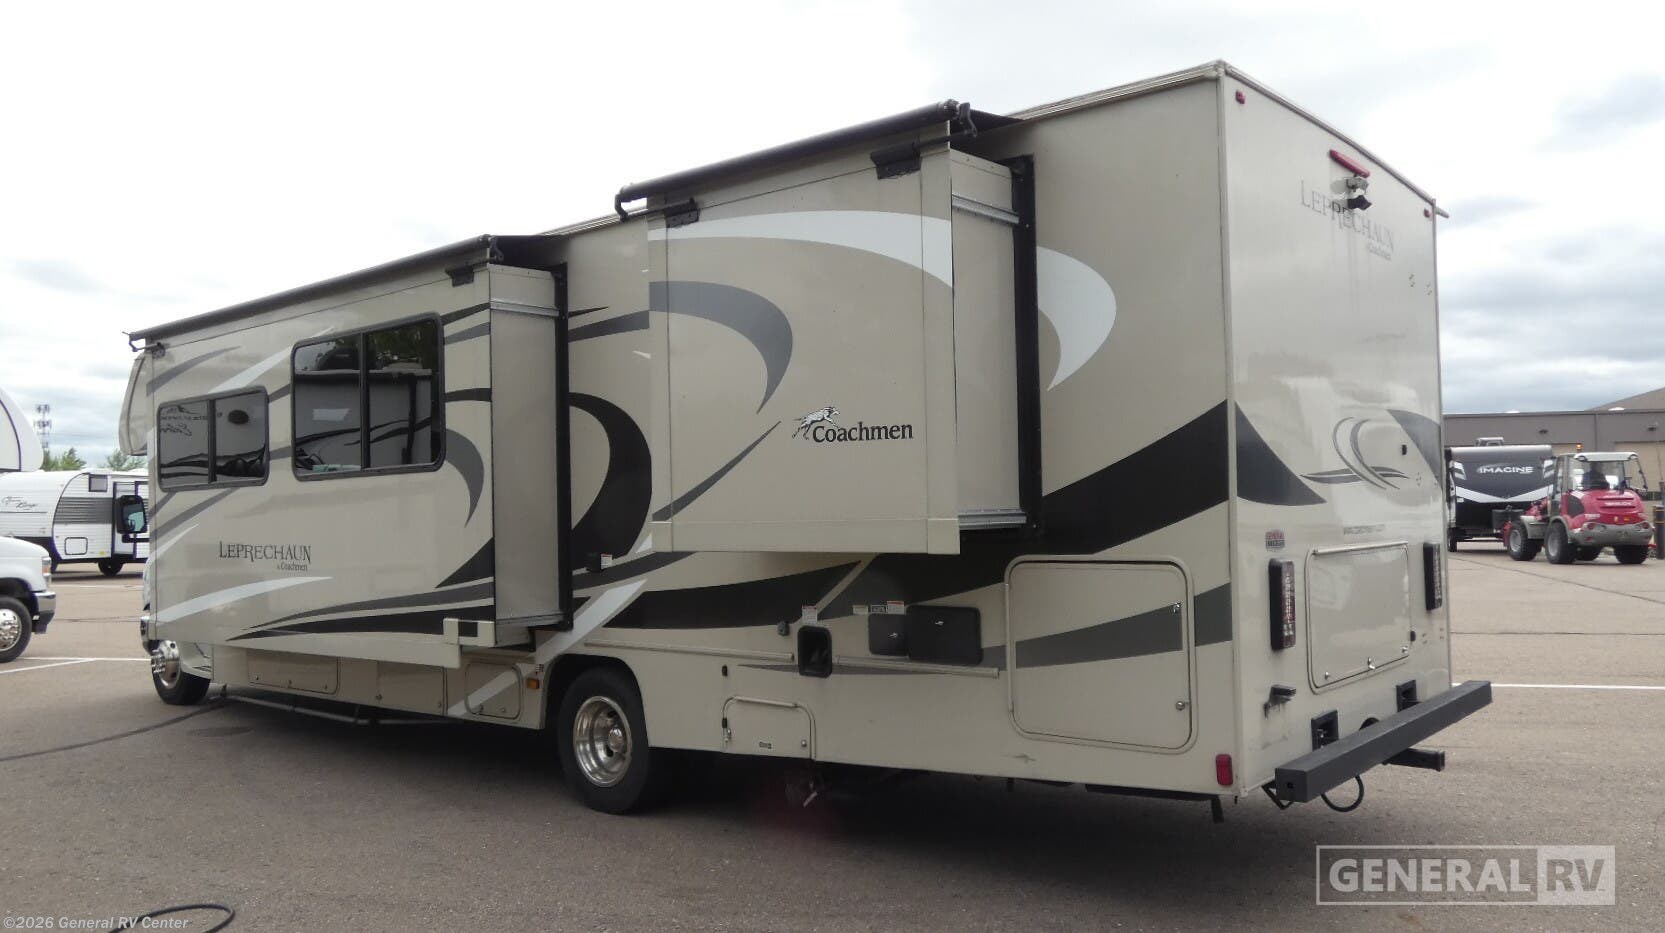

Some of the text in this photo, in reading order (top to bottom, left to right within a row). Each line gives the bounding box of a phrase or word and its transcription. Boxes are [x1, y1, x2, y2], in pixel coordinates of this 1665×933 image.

[812, 421, 914, 443] Coachmen
[1478, 466, 1534, 474] IMAGINE
[218, 540, 312, 564] LEPRECHAUN
